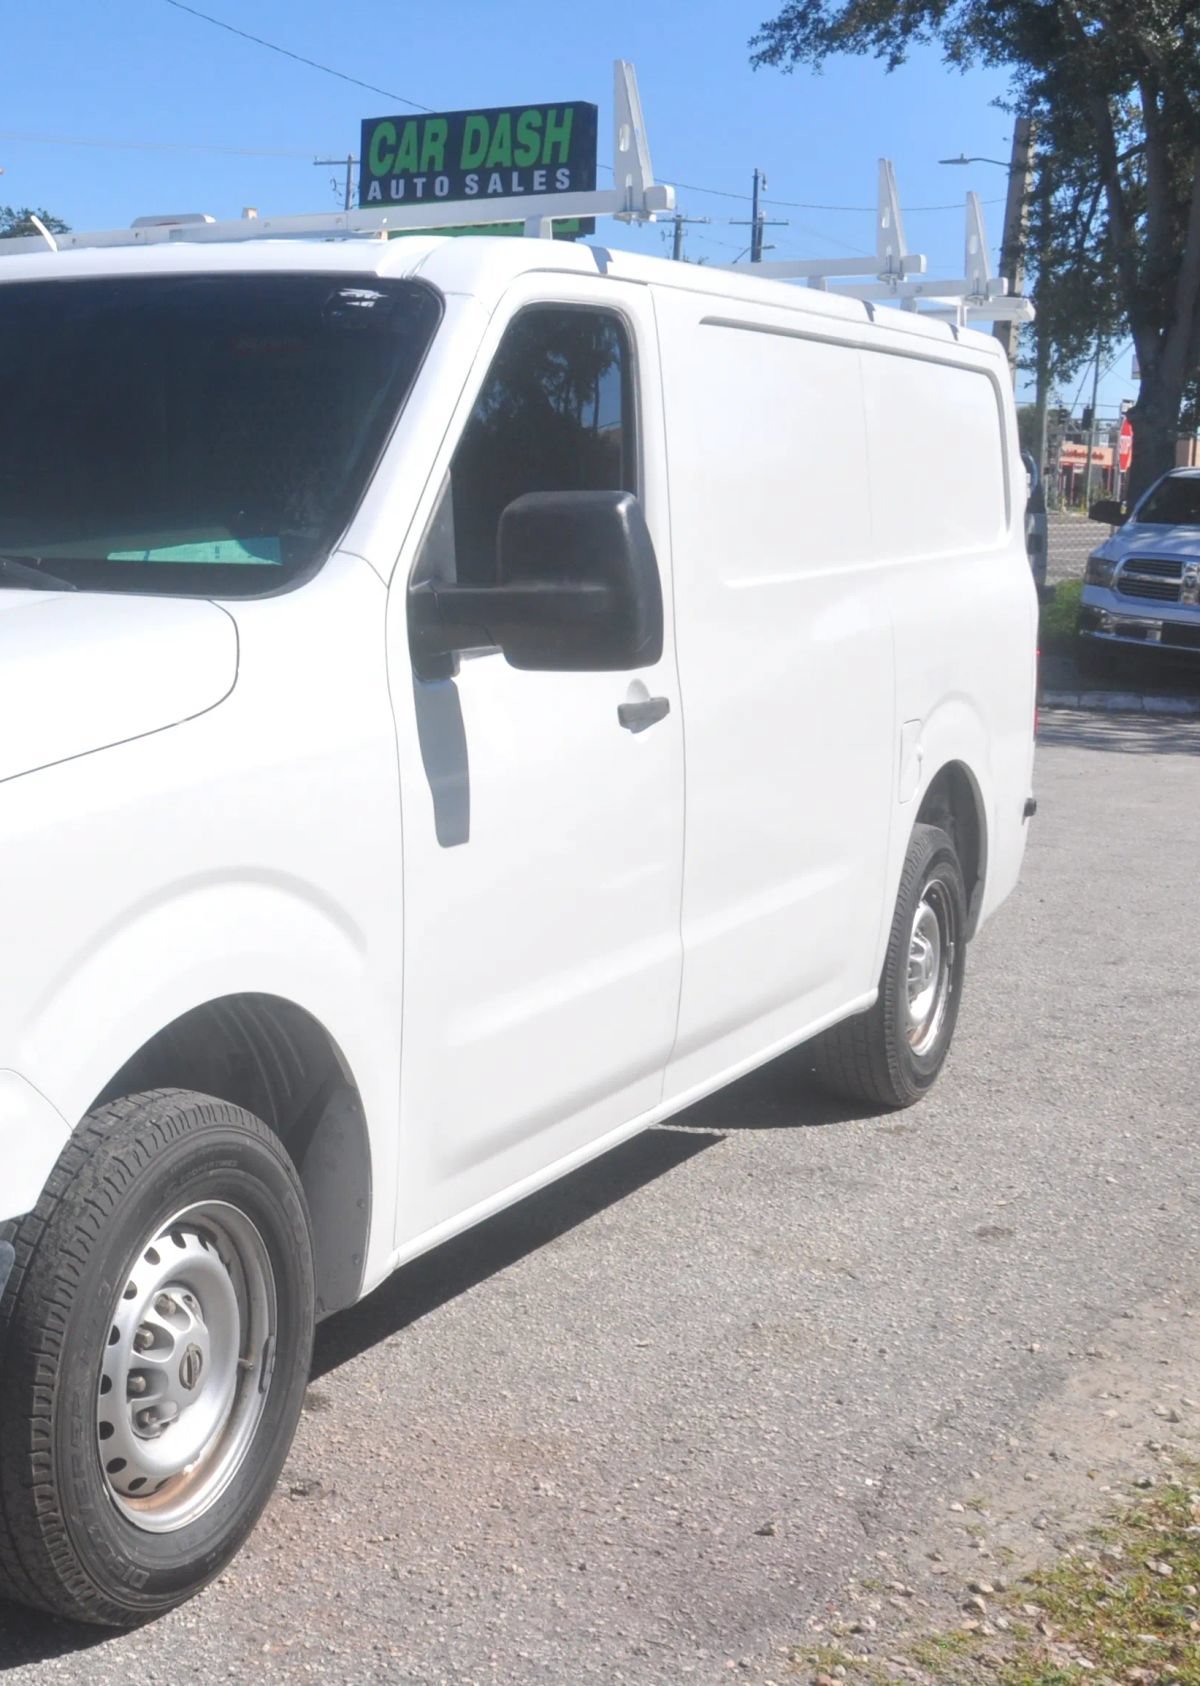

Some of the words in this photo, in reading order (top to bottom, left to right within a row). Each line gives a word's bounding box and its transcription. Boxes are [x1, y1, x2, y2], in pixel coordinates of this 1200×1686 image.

[369, 118, 448, 177] CAR
[460, 108, 574, 170] DASH
[368, 175, 449, 200] AUTO
[465, 168, 570, 194] SALES
